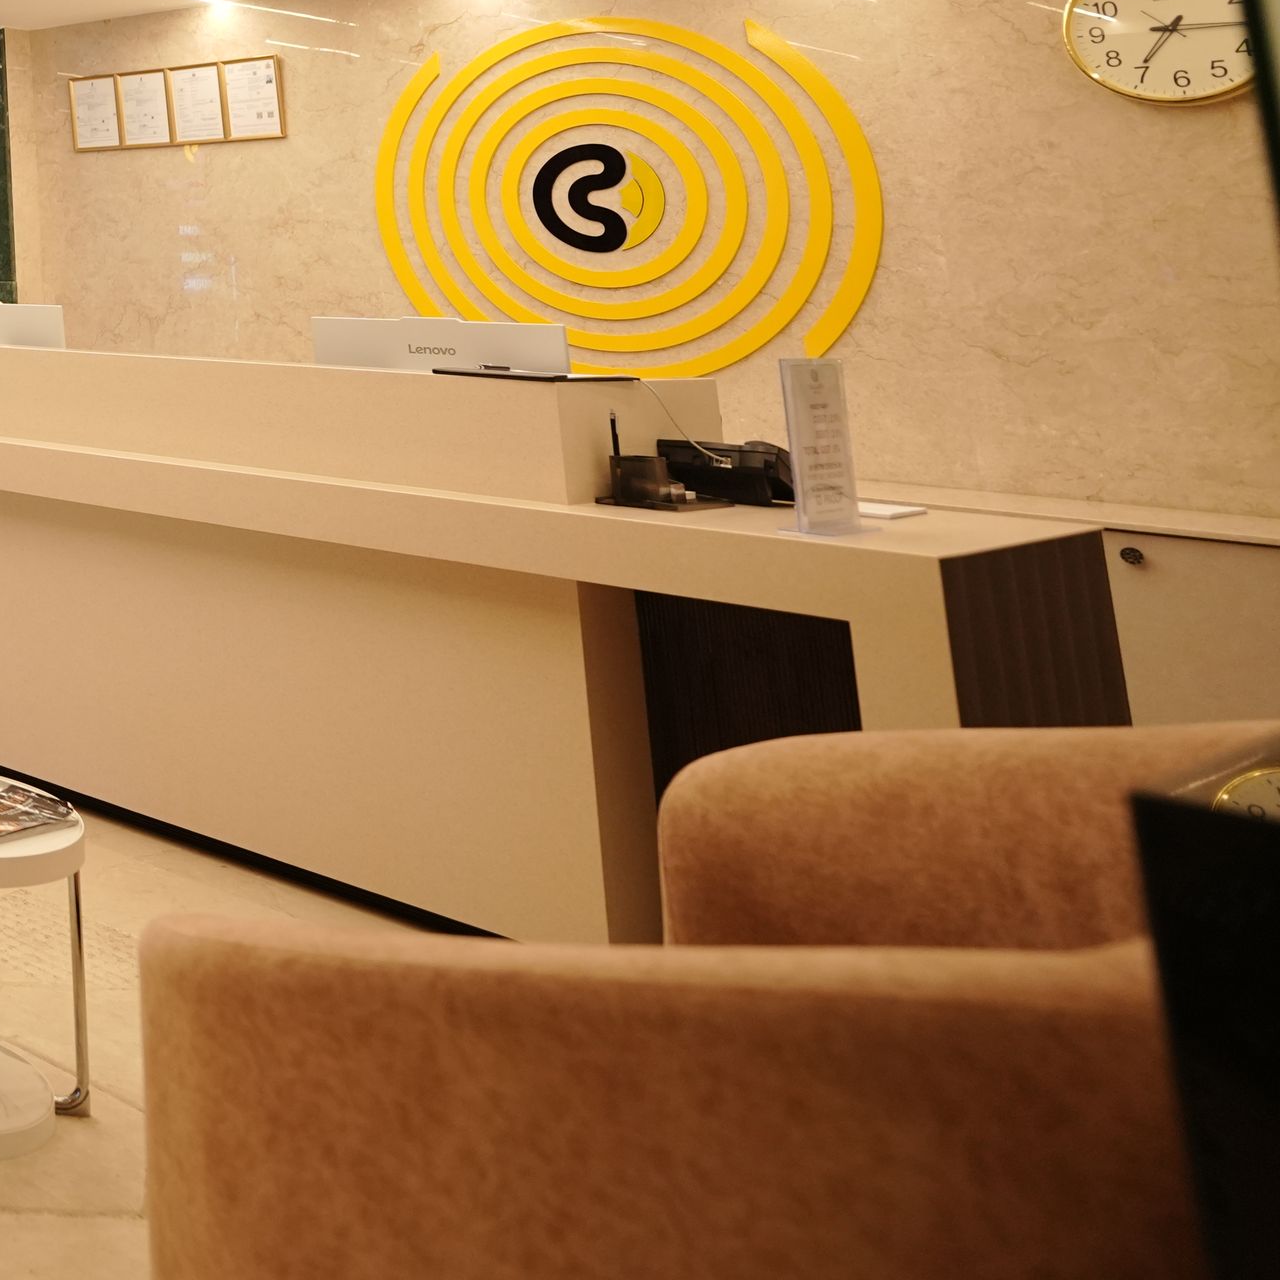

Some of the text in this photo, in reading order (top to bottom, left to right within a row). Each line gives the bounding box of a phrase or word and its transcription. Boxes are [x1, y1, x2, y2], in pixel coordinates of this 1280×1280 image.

[1094, 1, 1117, 18] 10
[1088, 27, 1105, 44] 9
[1236, 38, 1253, 56] 4
[1106, 50, 1122, 68] 8
[1134, 66, 1150, 84] 7
[1211, 60, 1228, 78] 5
[1174, 70, 1191, 88] 6
[408, 343, 456, 356] Lenovo
